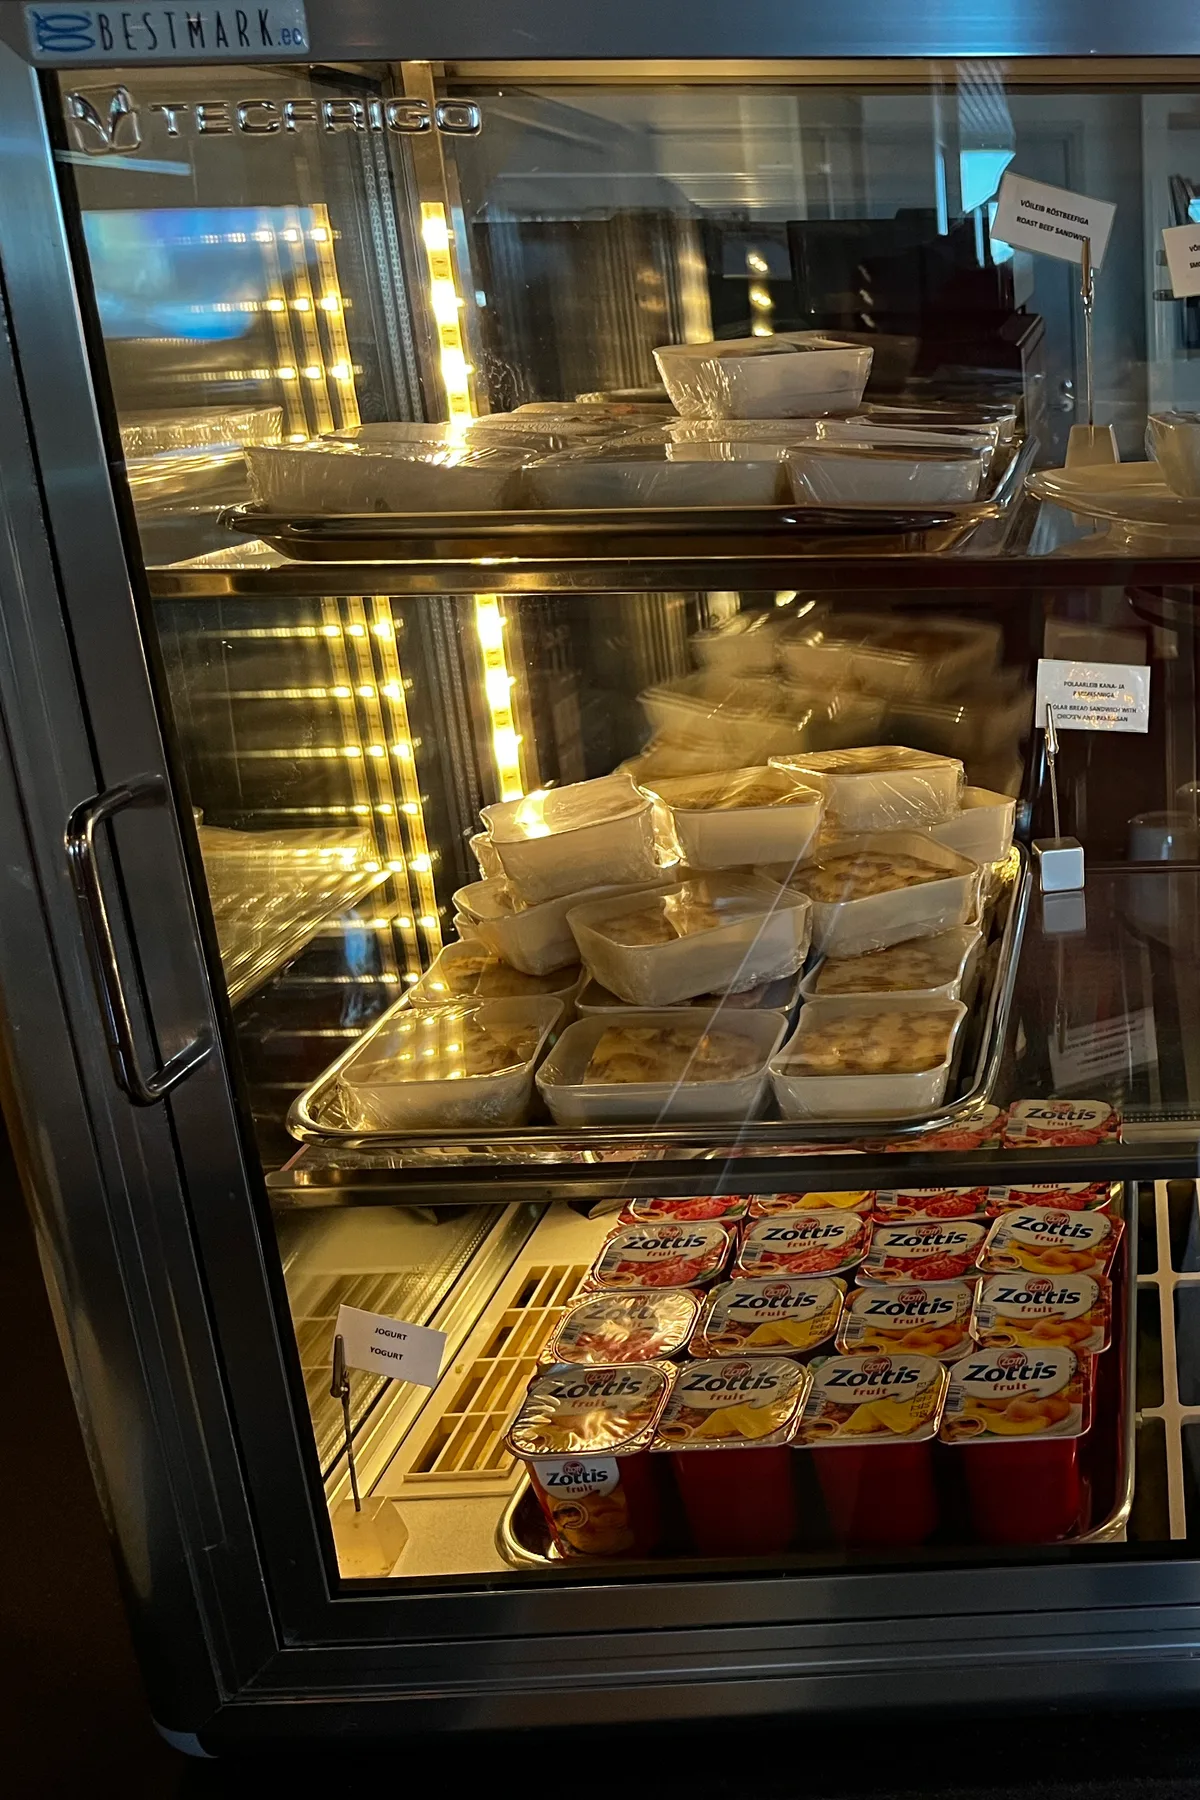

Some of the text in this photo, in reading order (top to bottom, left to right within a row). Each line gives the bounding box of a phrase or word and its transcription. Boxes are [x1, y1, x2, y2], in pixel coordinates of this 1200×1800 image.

[149, 97, 483, 137] TECFRIGO
[1020, 200, 1045, 213] VÕILEIB
[1016, 216, 1038, 227] ROAST
[1039, 222, 1054, 232] BEEF
[1122, 706, 1137, 714] WITH
[1024, 1108, 1097, 1120] Zottis
[761, 1224, 845, 1241] Zottis
[1011, 1216, 1094, 1239] Zottis
[621, 1234, 708, 1250] Zottis
[787, 1240, 817, 1248] fruit
[884, 1231, 968, 1247] Zottis
[1034, 1234, 1064, 1244] fruit
[646, 1249, 677, 1257] fruit
[727, 1292, 818, 1309] Zottis
[992, 1287, 1081, 1304] Zottis
[754, 1309, 787, 1317] fruit
[864, 1297, 955, 1316] Zottis
[1020, 1305, 1054, 1313] fruit
[374, 1327, 408, 1341] JOGURT
[369, 1346, 404, 1361] YOGURT
[824, 1366, 921, 1387] Zottis
[962, 1362, 1058, 1382] Zottis
[548, 1376, 642, 1398] Zottis
[682, 1372, 781, 1391] Zottis
[993, 1382, 1028, 1391] fruit
[709, 1392, 745, 1401] fruit
[853, 1387, 888, 1396] fruit
[546, 1469, 608, 1486] Zottis
[566, 1484, 593, 1493] fruit
